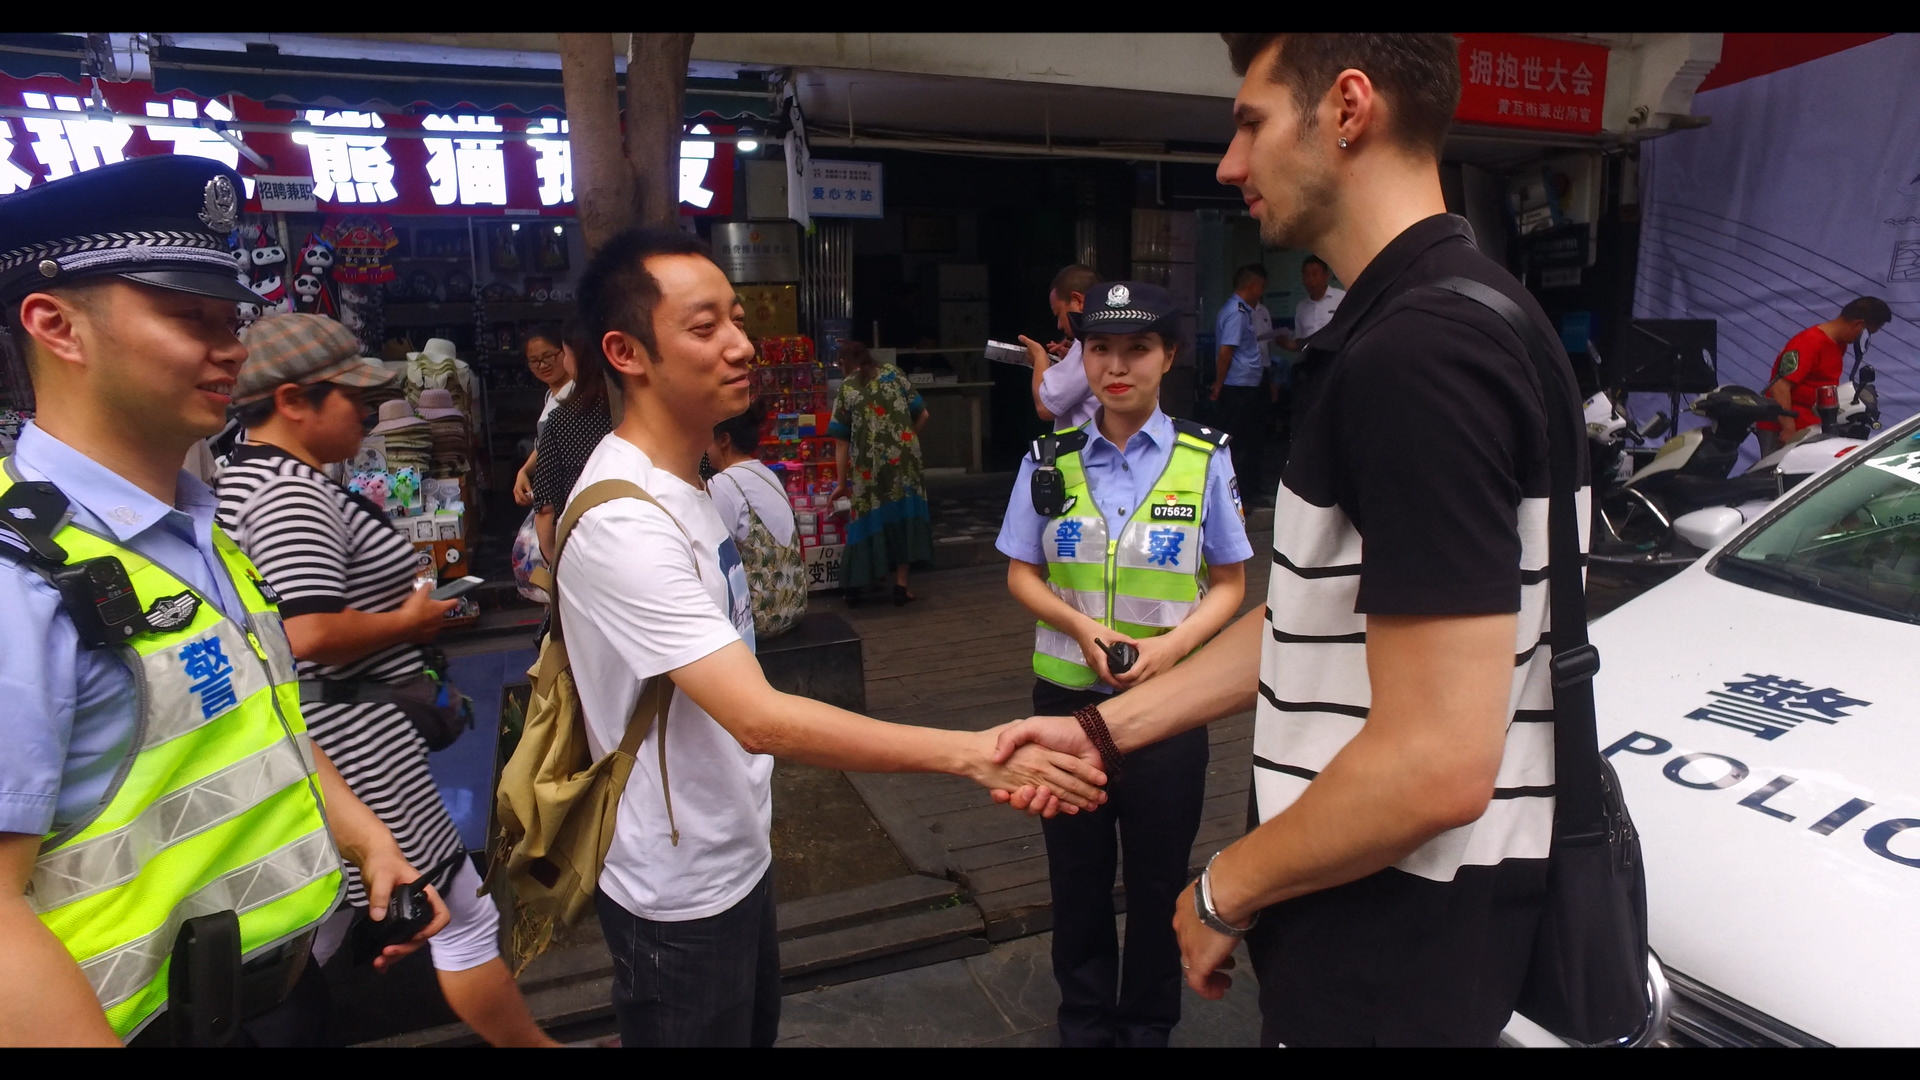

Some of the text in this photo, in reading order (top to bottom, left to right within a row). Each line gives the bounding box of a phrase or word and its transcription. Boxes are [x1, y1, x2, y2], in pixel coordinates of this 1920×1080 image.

[1468, 48, 1593, 96] 拥抱世大会
[1497, 98, 1592, 123] 黄瓦街派出所宣
[258, 181, 314, 201] 招聘兼职
[812, 186, 873, 202] 爱心水站
[1154, 506, 1194, 518] 075622
[1054, 519, 1185, 567] 警 察
[808, 559, 840, 585] 变脸
[178, 635, 238, 720] 警
[1683, 672, 1874, 742] 警
